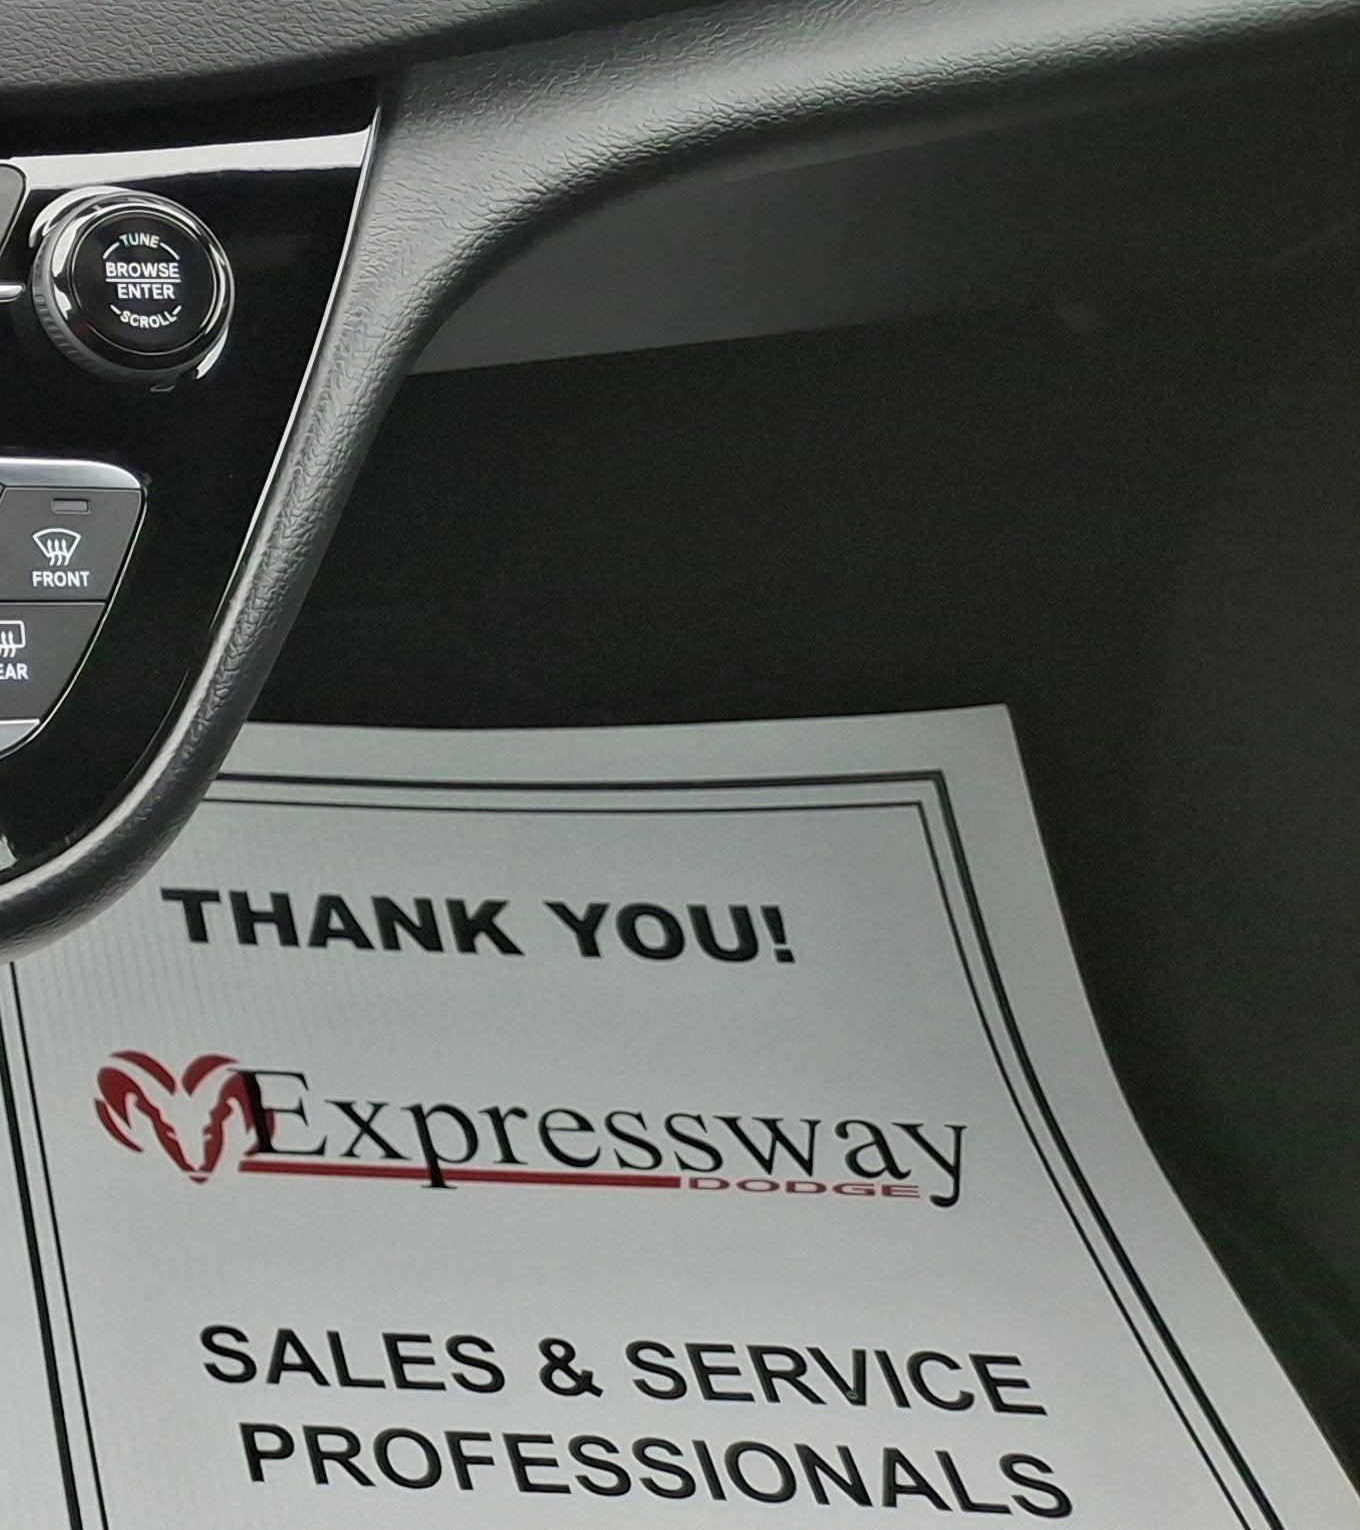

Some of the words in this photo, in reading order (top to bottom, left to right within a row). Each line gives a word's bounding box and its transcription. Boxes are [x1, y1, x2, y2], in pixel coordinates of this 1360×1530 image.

[119, 233, 160, 250] TUNE
[105, 261, 180, 279] BROWSE
[117, 282, 175, 300] ENTER
[118, 309, 178, 330] SCROLL
[32, 571, 90, 588] FRONT
[161, 887, 524, 959] THANK
[545, 900, 798, 965] YOU!
[230, 1068, 970, 1209] Expressway
[686, 1174, 922, 1202] DODGE
[198, 1322, 507, 1399] SALES
[538, 1334, 603, 1400] &
[628, 1338, 1048, 1419] SERVICE
[238, 1420, 1075, 1520] PROFESSIONALS
